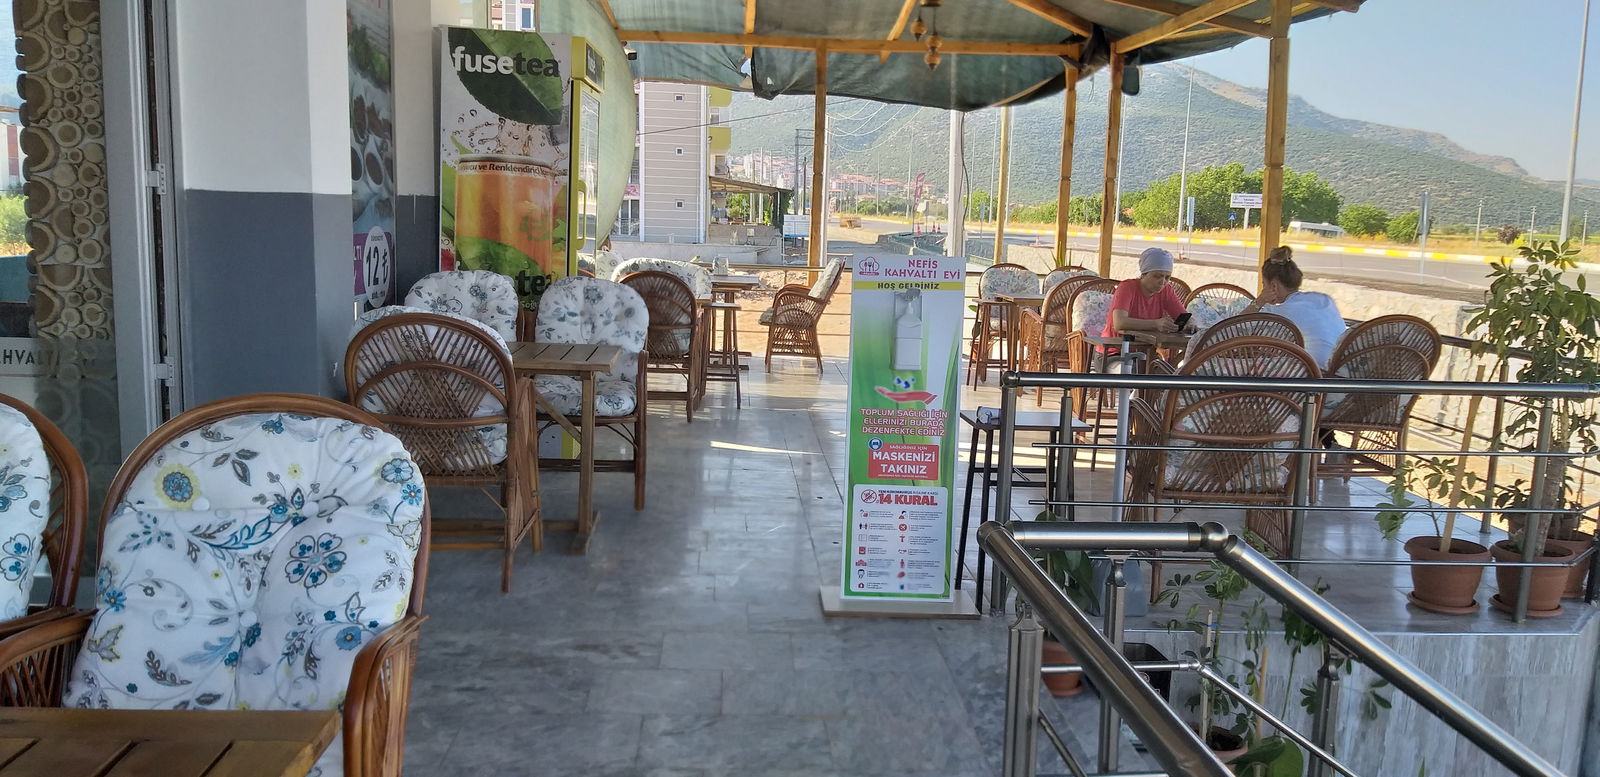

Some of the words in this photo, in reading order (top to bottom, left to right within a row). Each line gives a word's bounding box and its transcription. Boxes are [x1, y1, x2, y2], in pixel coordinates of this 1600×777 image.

[908, 258, 938, 269] NEFİS
[884, 268, 936, 278] KAHVALTI
[943, 269, 961, 280] EVİ
[877, 282, 896, 291] HOŞ
[861, 408, 895, 416] TOPLUM
[897, 408, 930, 418] SAĞLIĞI
[910, 419, 945, 427] BURADA
[862, 427, 915, 435] DEZENFEKTE
[917, 427, 945, 436] EDİNİZ
[872, 451, 935, 462] MASKENİZİ
[881, 464, 927, 474] TAKINIZ
[878, 493, 892, 504] 14
[895, 494, 938, 506] KURAL
